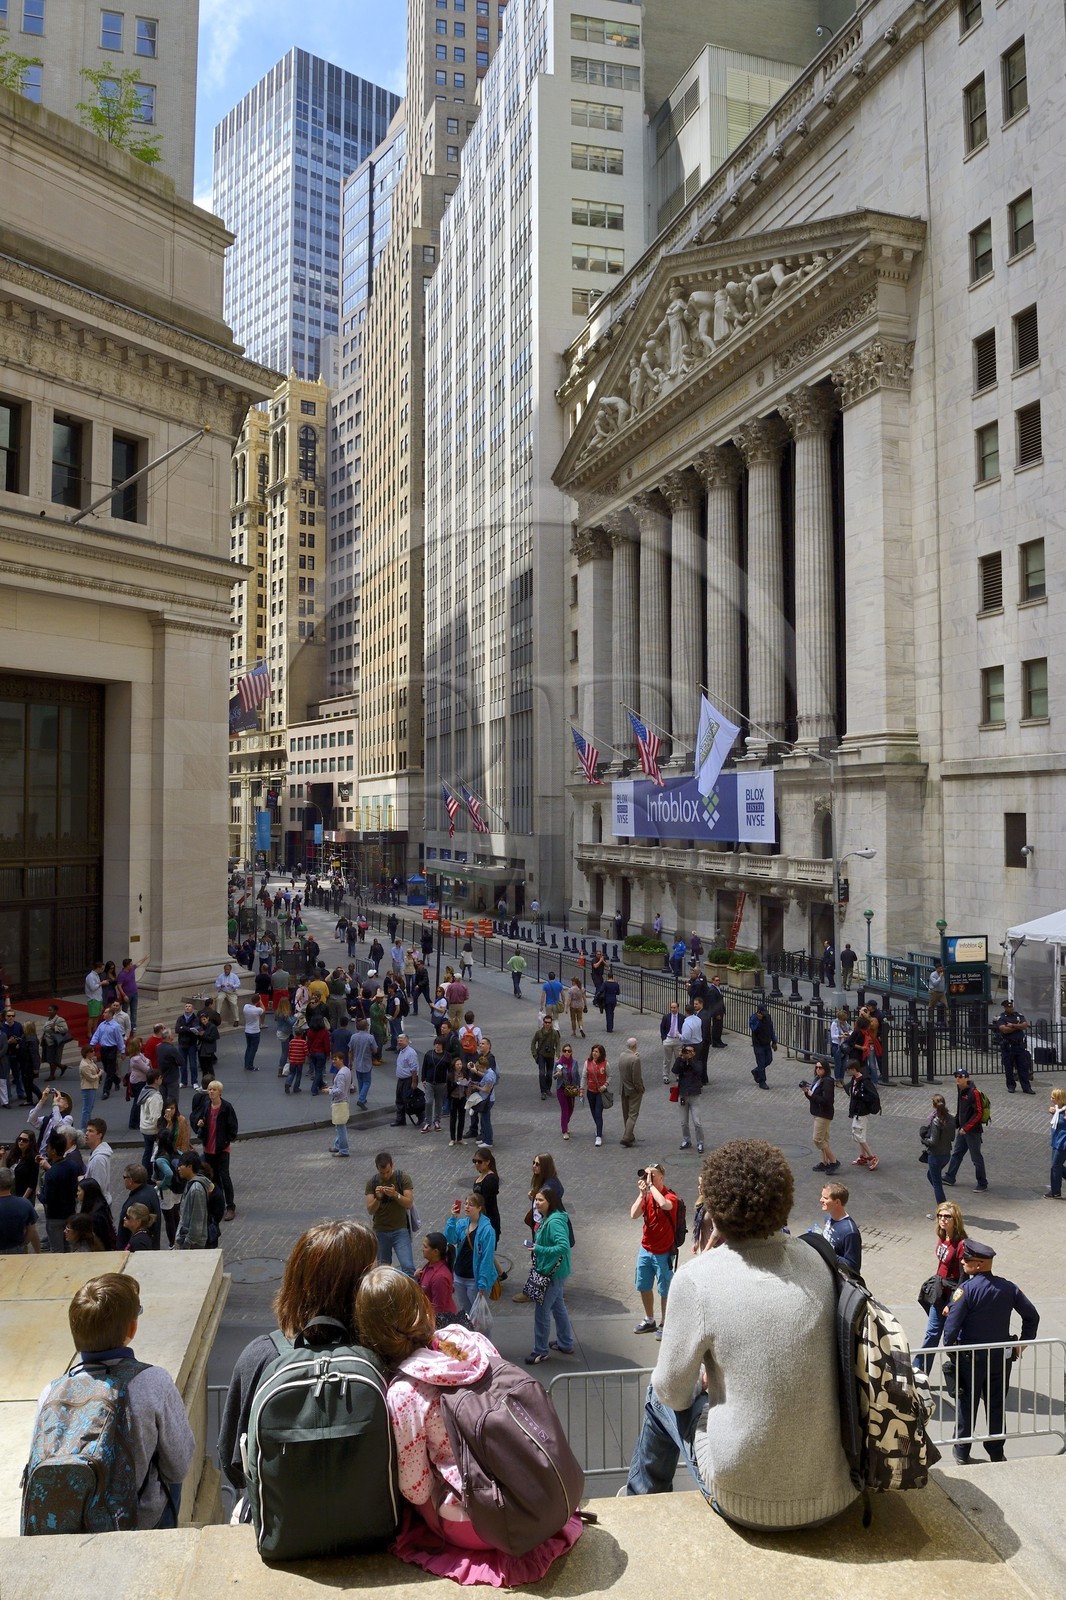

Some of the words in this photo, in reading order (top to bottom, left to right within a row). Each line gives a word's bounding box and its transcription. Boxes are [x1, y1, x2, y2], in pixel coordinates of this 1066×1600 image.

[746, 788, 765, 801] BLOX
[646, 792, 701, 823] Infoblox
[746, 803, 765, 812] LISTED
[616, 814, 629, 824] NYSE
[746, 814, 765, 826] NYSE
